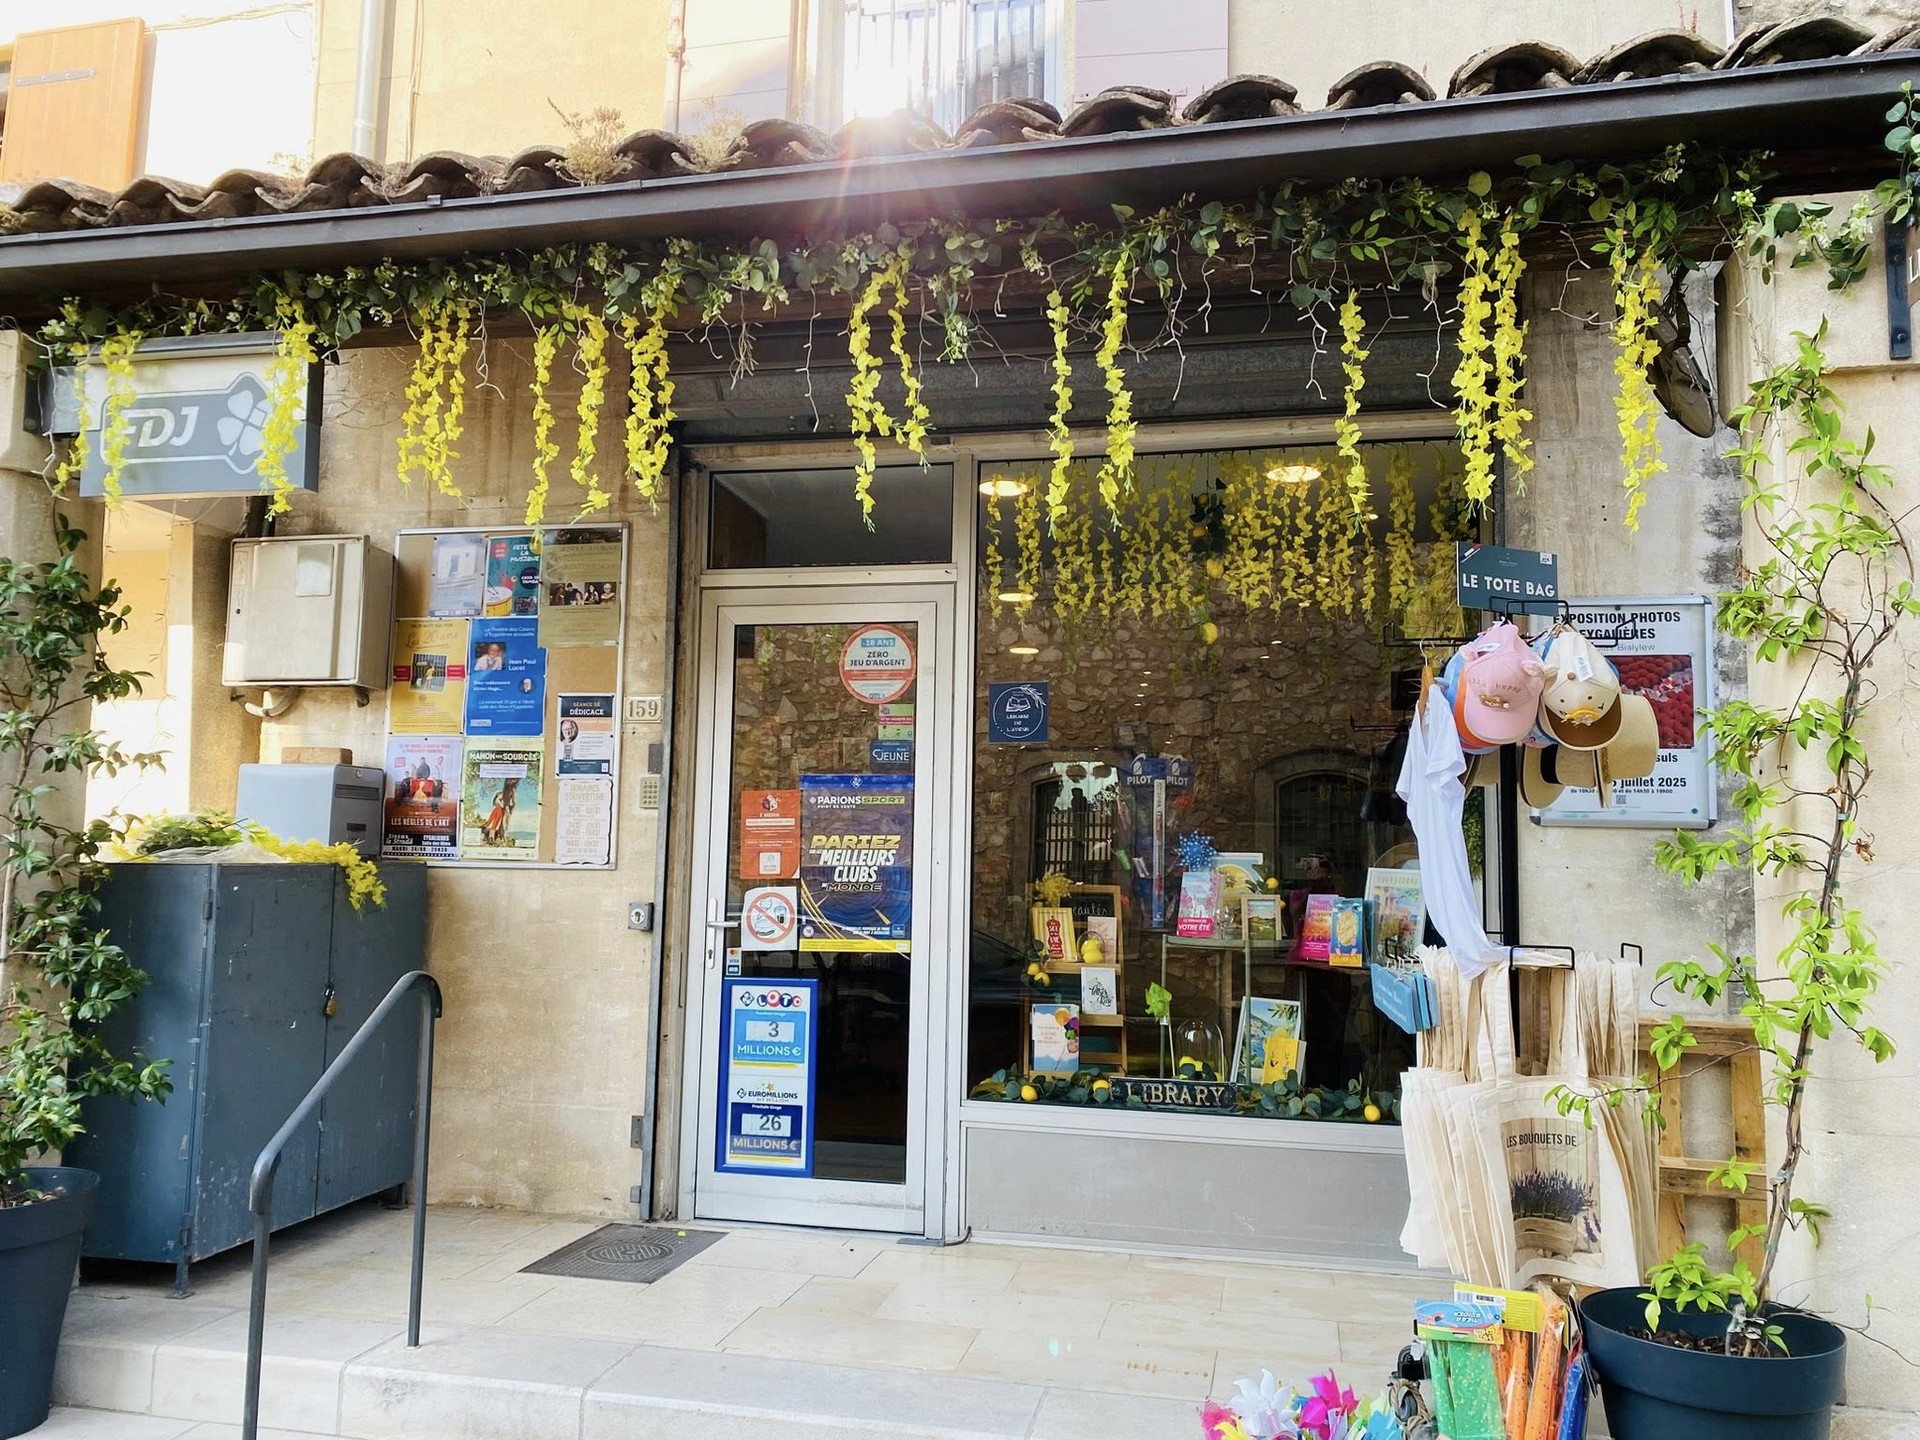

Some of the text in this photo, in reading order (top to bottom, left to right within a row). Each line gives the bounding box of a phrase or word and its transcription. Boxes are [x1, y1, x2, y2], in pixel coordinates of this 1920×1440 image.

[1462, 573, 1555, 597] LE TOTE BAG
[1553, 612, 1681, 624] EXPOSITION PHOTOS
[629, 700, 658, 717] 159
[1656, 753, 1678, 762] suls
[1127, 776, 1152, 784] PILOT
[1167, 776, 1188, 785] PILOT
[1620, 777, 1654, 788] juillet
[1658, 777, 1687, 787] 2025
[817, 796, 861, 804] PARIONS
[810, 835, 901, 849] PARIEZ
[819, 850, 897, 866] MEILLEURS
[834, 866, 877, 882] CLUBS
[826, 883, 883, 892] MONDE
[757, 990, 802, 1008] LOTO
[768, 1021, 779, 1037] 3
[737, 1045, 801, 1056] MILLIONS €
[748, 1091, 798, 1099] EUROMILLIONS
[1126, 1082, 1224, 1106] LIBRARY
[760, 1114, 781, 1131] 26
[734, 1138, 787, 1150] MILLIONS
[1506, 1132, 1576, 1148] LES BOUQUETS DE
